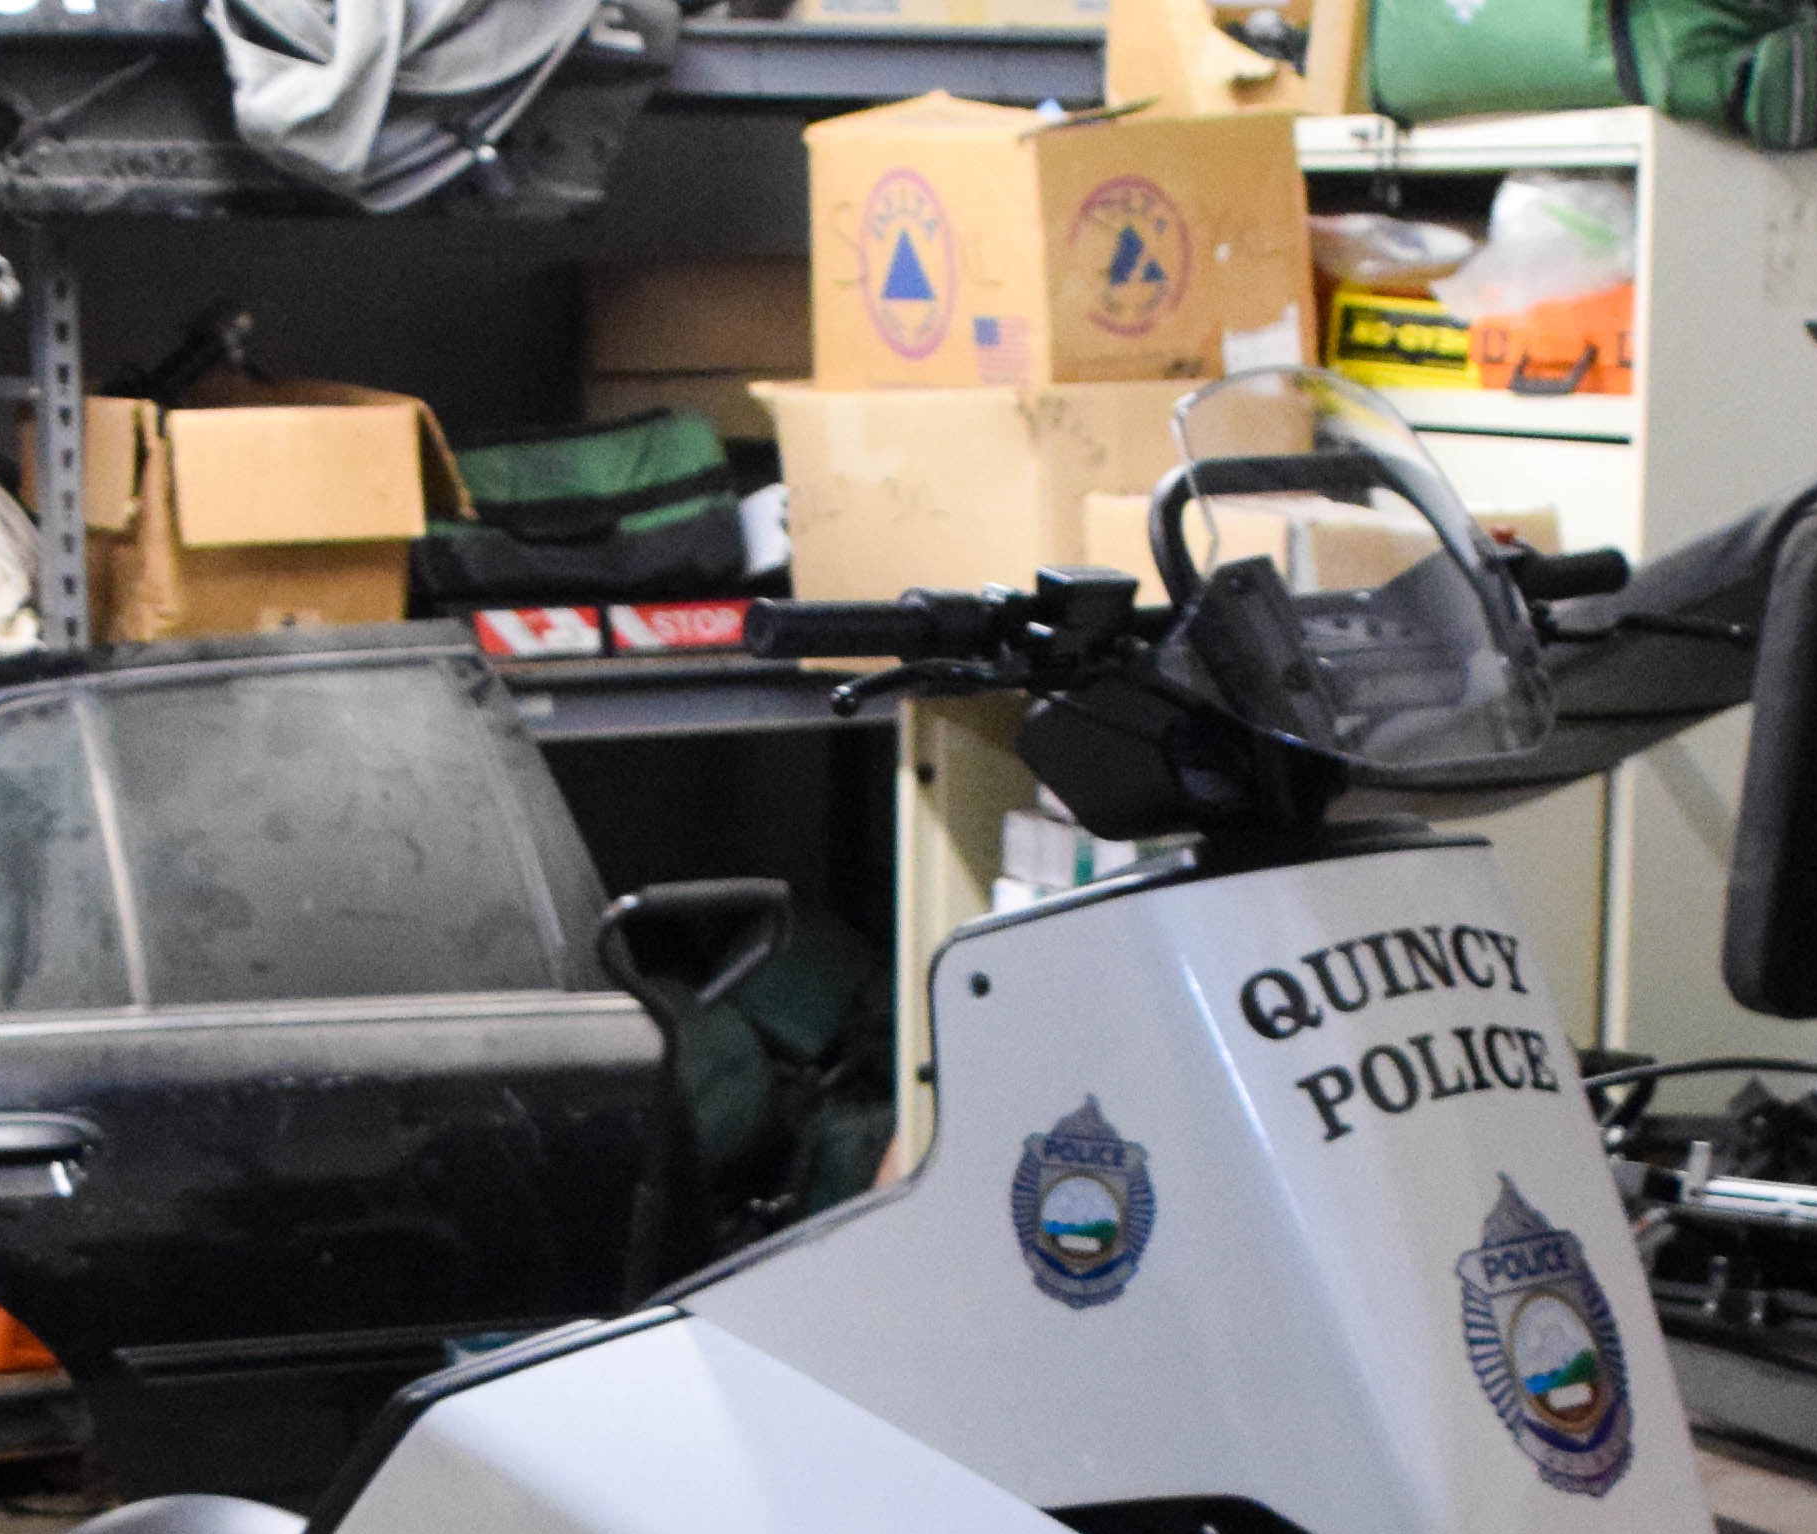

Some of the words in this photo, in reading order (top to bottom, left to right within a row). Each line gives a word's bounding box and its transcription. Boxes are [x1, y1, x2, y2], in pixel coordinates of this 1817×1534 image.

[1239, 924, 1529, 1040] QUINCY
[1295, 1024, 1559, 1143] POLICE
[1045, 1138, 1125, 1168] POLICE
[1482, 1240, 1569, 1284] POLICE
